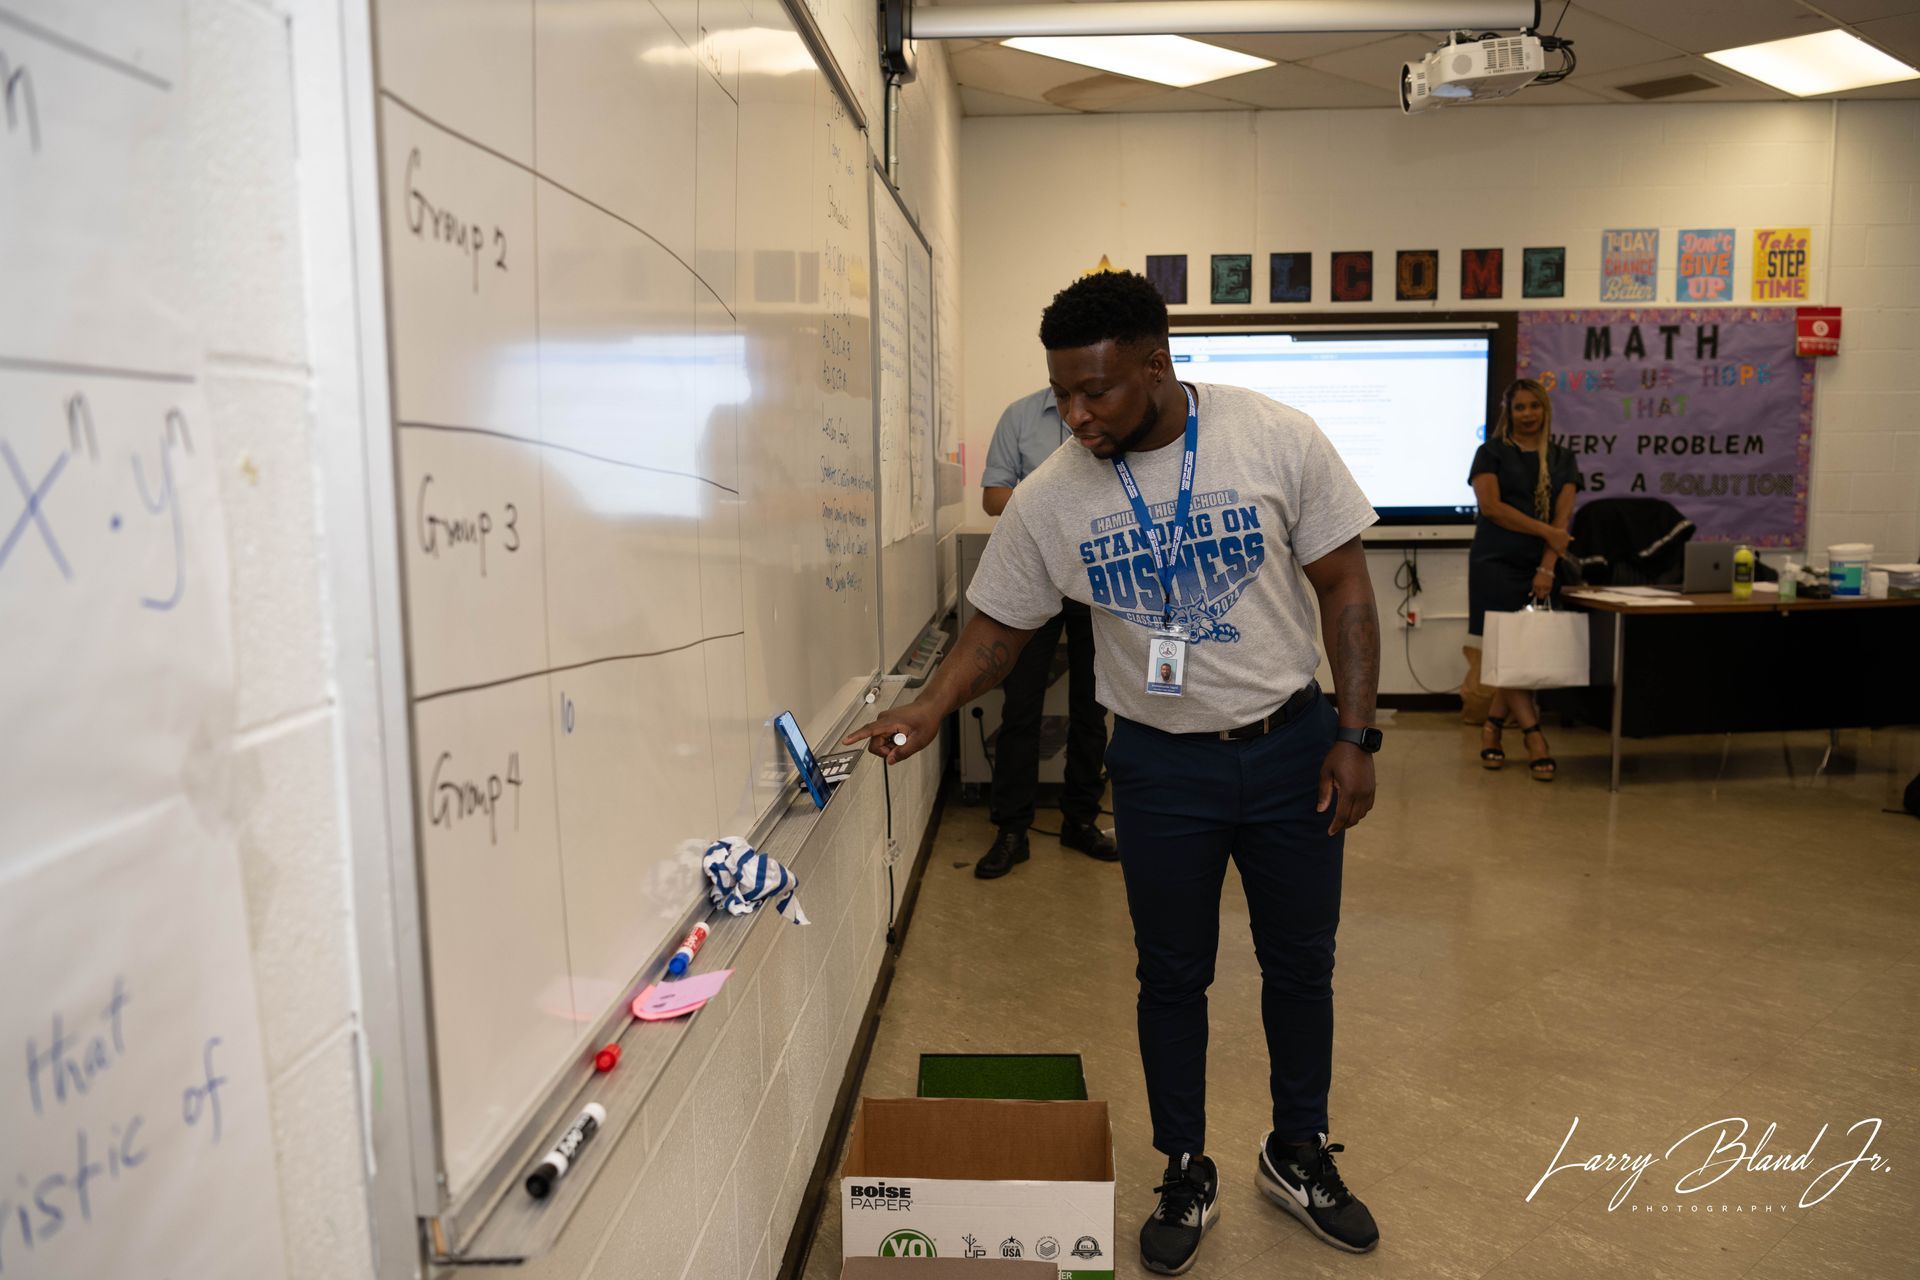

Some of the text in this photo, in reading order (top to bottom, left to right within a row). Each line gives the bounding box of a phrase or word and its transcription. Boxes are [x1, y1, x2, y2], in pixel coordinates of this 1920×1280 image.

[404, 147, 509, 294] Group 2
[1680, 233, 1732, 254] Don't
[1757, 231, 1807, 251] Take
[1680, 253, 1730, 276] GIVE
[1767, 250, 1806, 278] STEP
[1687, 277, 1726, 299] UP
[1756, 279, 1806, 299] TIME
[1584, 325, 1719, 361] MATH
[1537, 362, 1776, 392] GIVES US HOPE
[1622, 394, 1690, 419] THAT
[1550, 434, 1764, 455] VERY PROBLEM
[1631, 473, 1647, 492] A
[1660, 472, 1794, 496] SOLUTION
[417, 474, 520, 578] Group 3
[1097, 507, 1152, 532] HAMILT
[1155, 501, 1177, 517] HIG
[1222, 506, 1260, 533] ON
[1214, 590, 1240, 617] 2024
[1127, 612, 1150, 624] CLASS
[428, 751, 522, 846] Group 4
[26, 973, 132, 1116] that
[183, 1035, 228, 1146] of
[1003, 1247, 1021, 1257] USA
